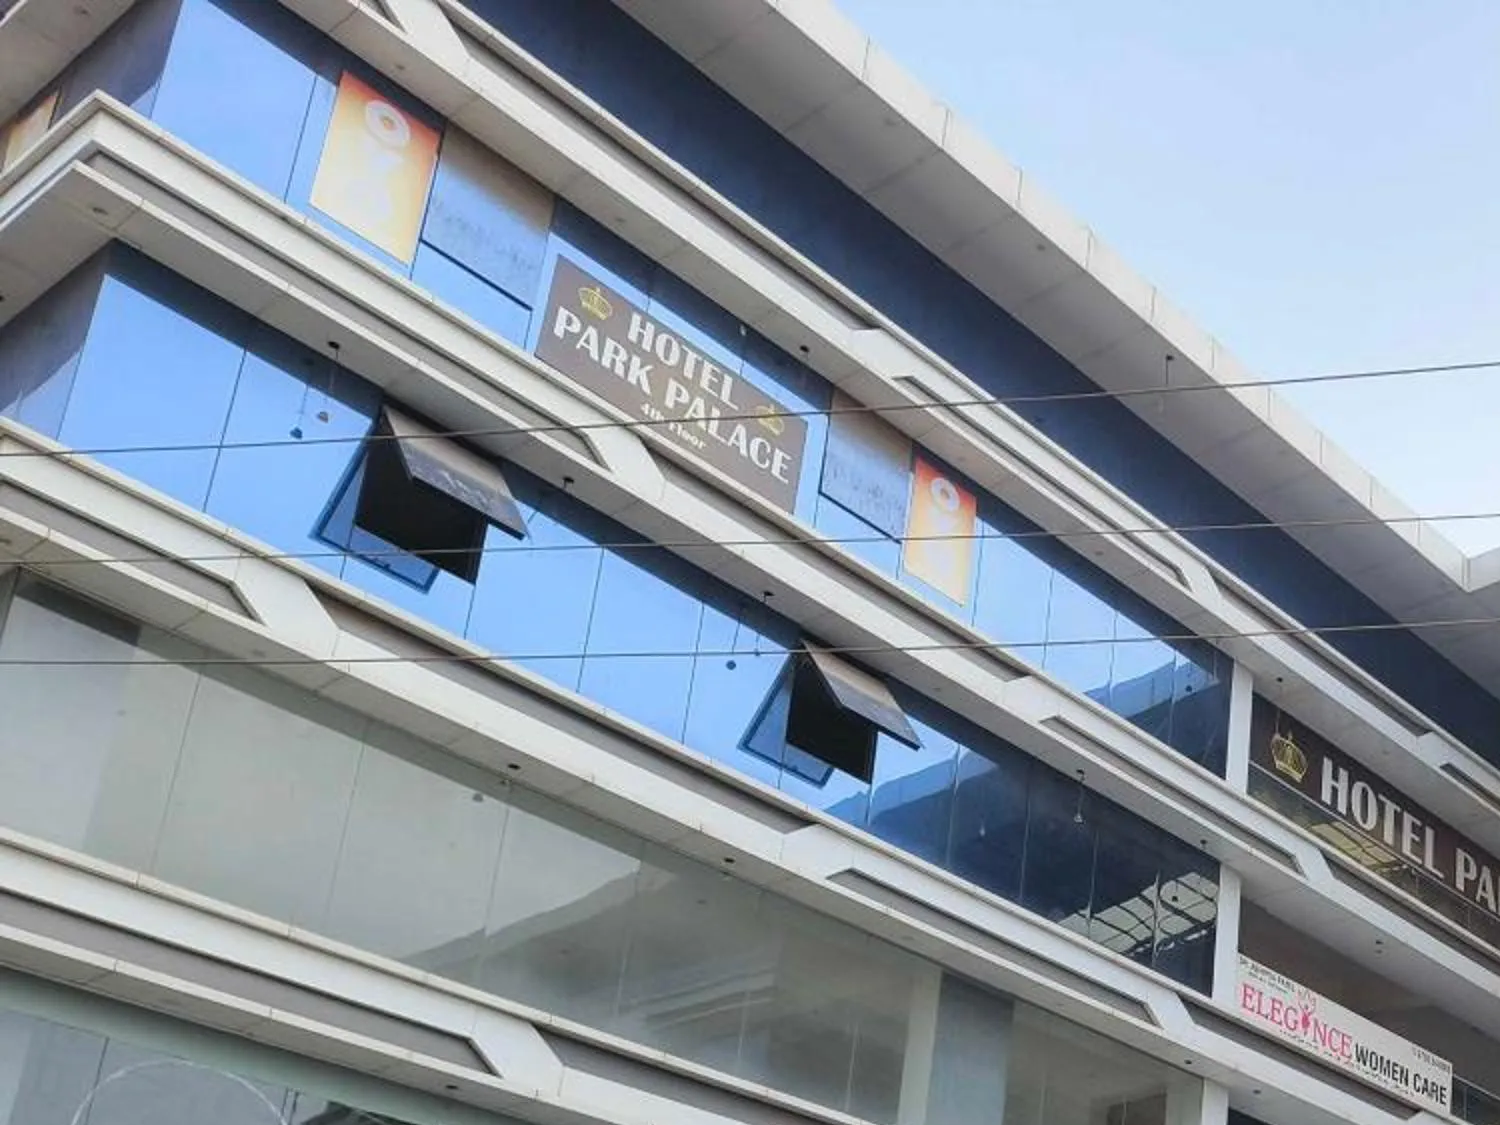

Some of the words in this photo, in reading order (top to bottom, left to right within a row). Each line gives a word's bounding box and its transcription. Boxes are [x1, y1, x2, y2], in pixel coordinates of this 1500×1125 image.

[552, 305, 656, 397] PARK
[664, 377, 793, 485] PALACE
[627, 310, 740, 411] HOTEL
[1320, 755, 1446, 880] HOTEL
[1354, 1043, 1410, 1087] WOMEN
[1412, 1071, 1448, 1106] CARE
